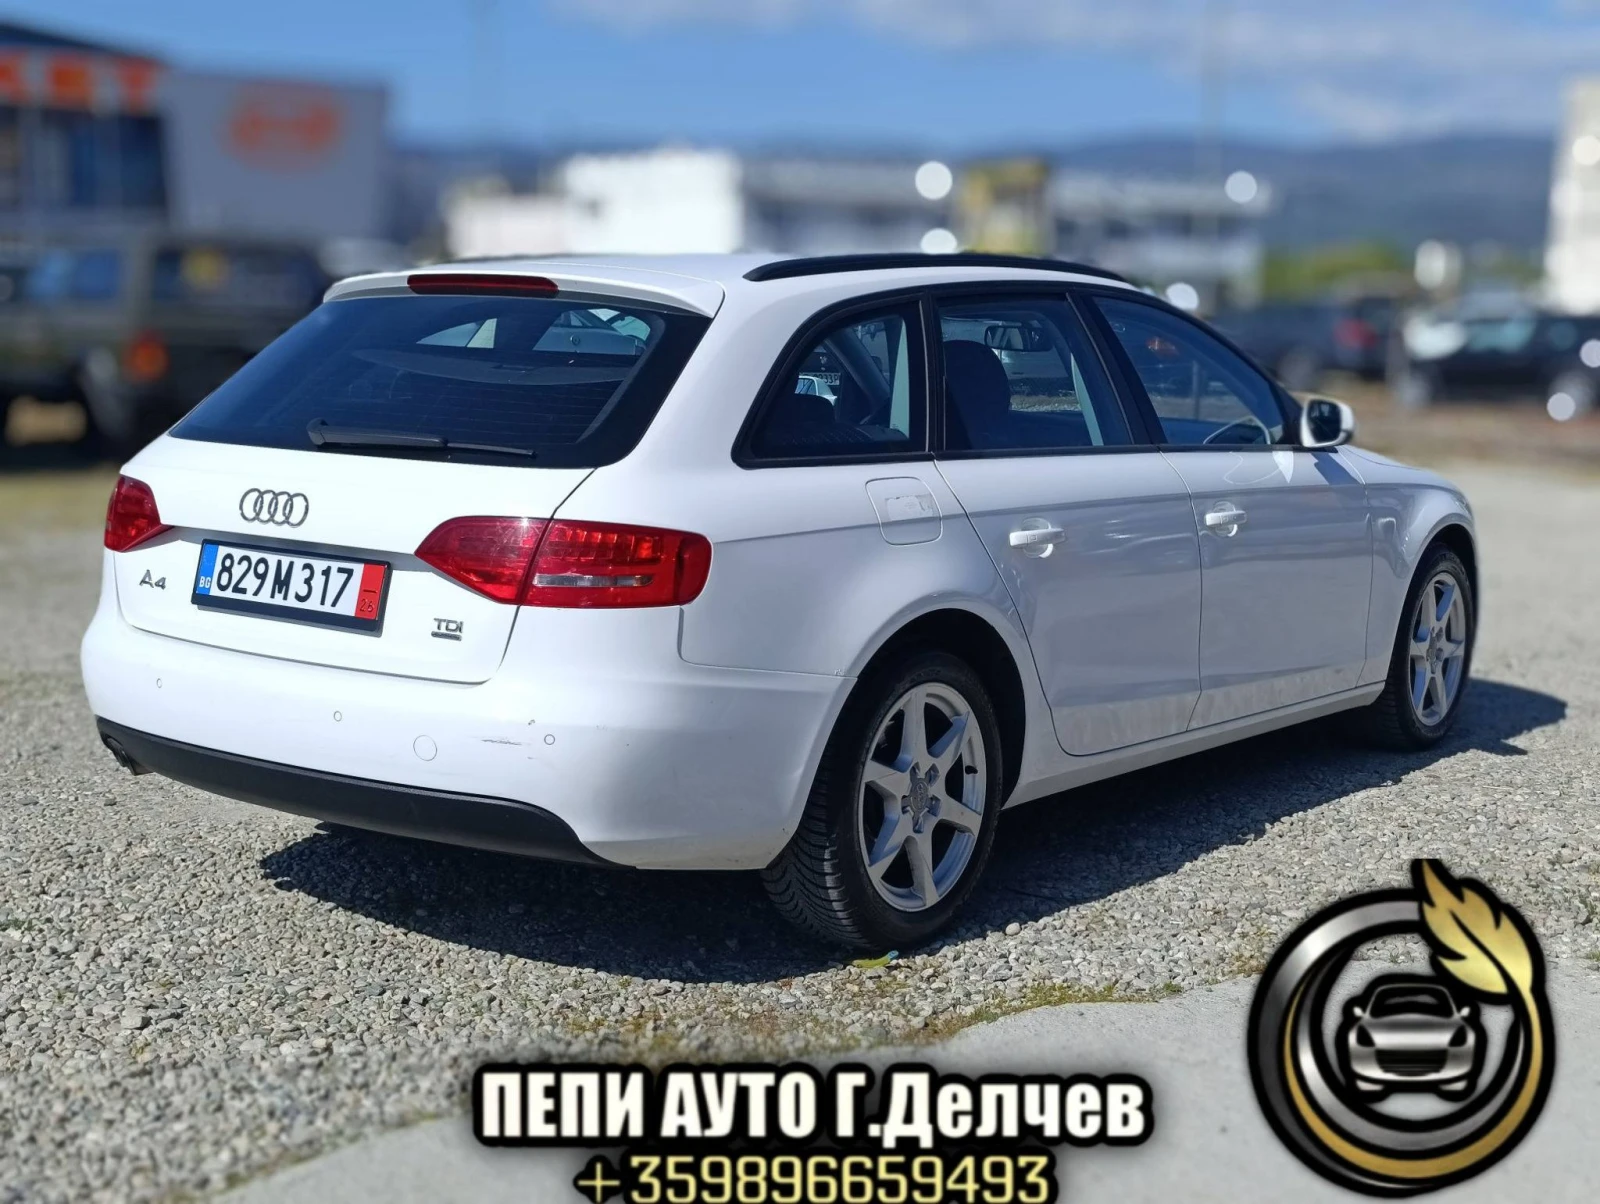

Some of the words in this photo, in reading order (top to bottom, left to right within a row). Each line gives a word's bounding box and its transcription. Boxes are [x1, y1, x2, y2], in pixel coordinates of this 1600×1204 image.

[139, 569, 166, 590] A4
[199, 575, 212, 589] BG
[216, 552, 355, 608] 829M317
[359, 598, 374, 613] 26
[433, 617, 464, 634] TDI
